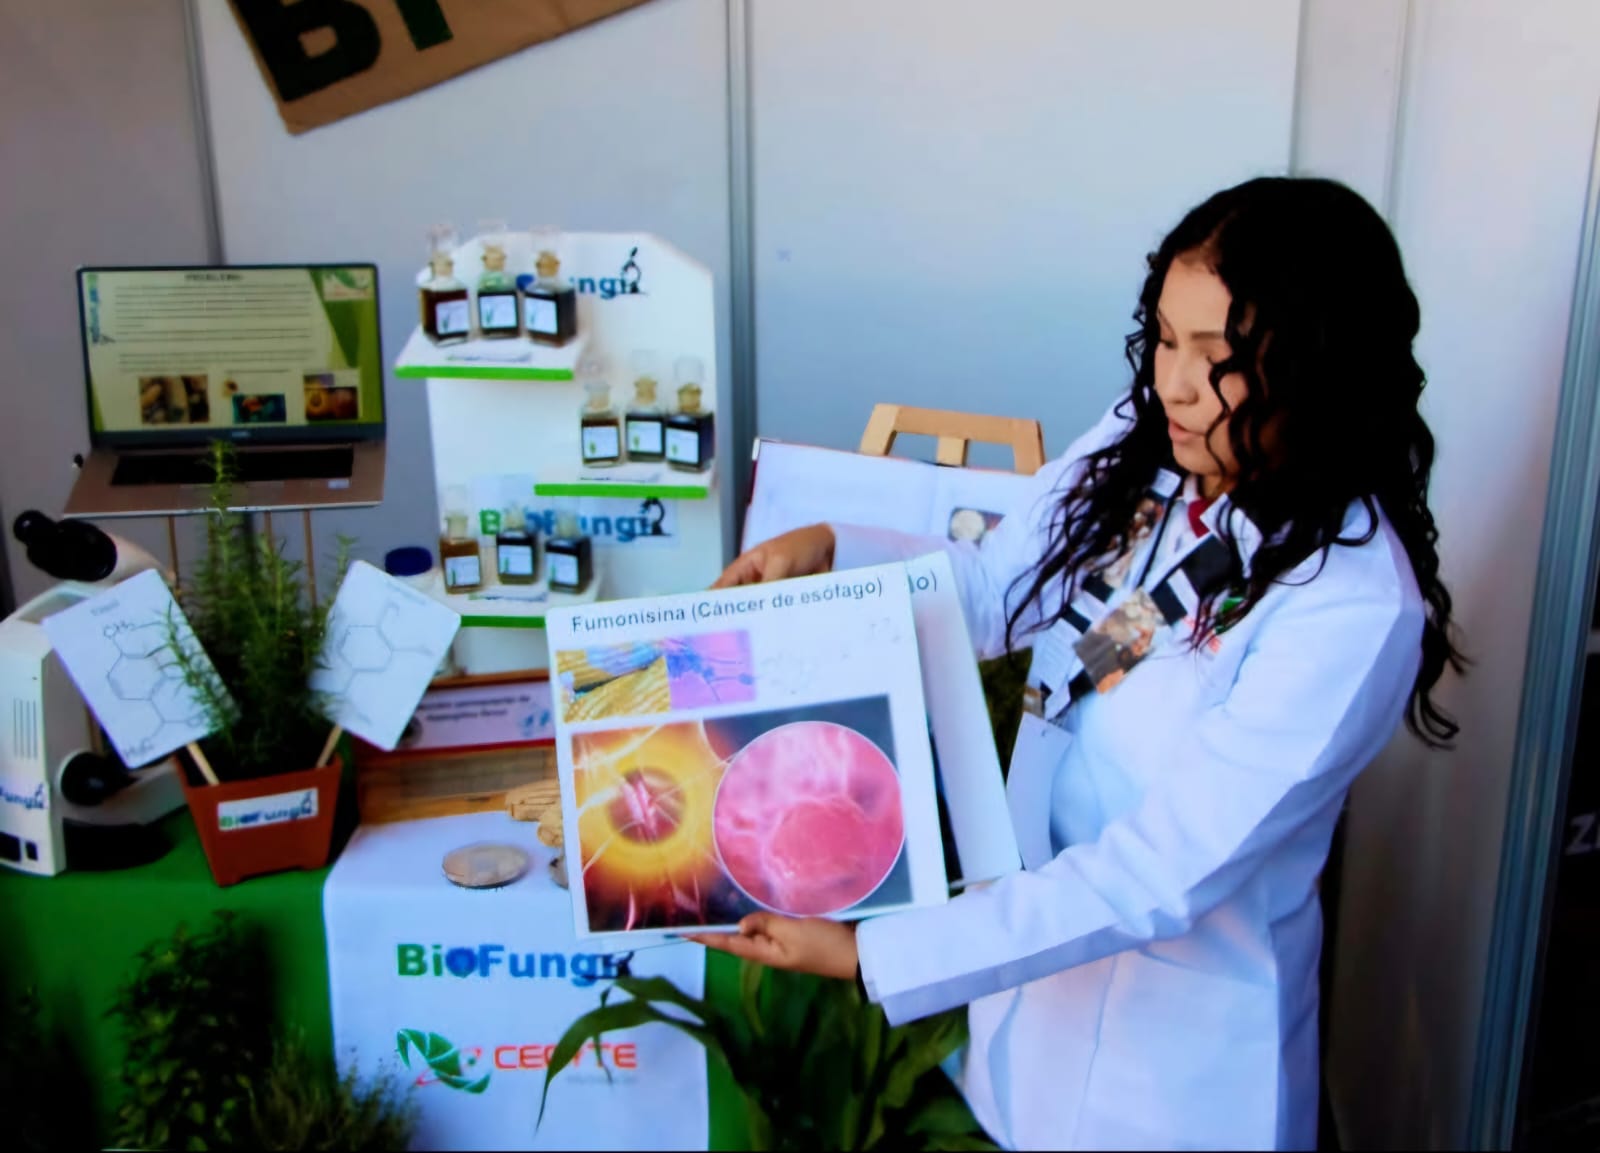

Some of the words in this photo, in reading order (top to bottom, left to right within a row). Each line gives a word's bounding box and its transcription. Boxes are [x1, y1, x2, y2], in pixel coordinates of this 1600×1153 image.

[571, 606, 685, 633] Fumonisina
[692, 598, 765, 623] (Cáncer
[772, 593, 794, 609] de
[800, 576, 882, 605] esófago)
